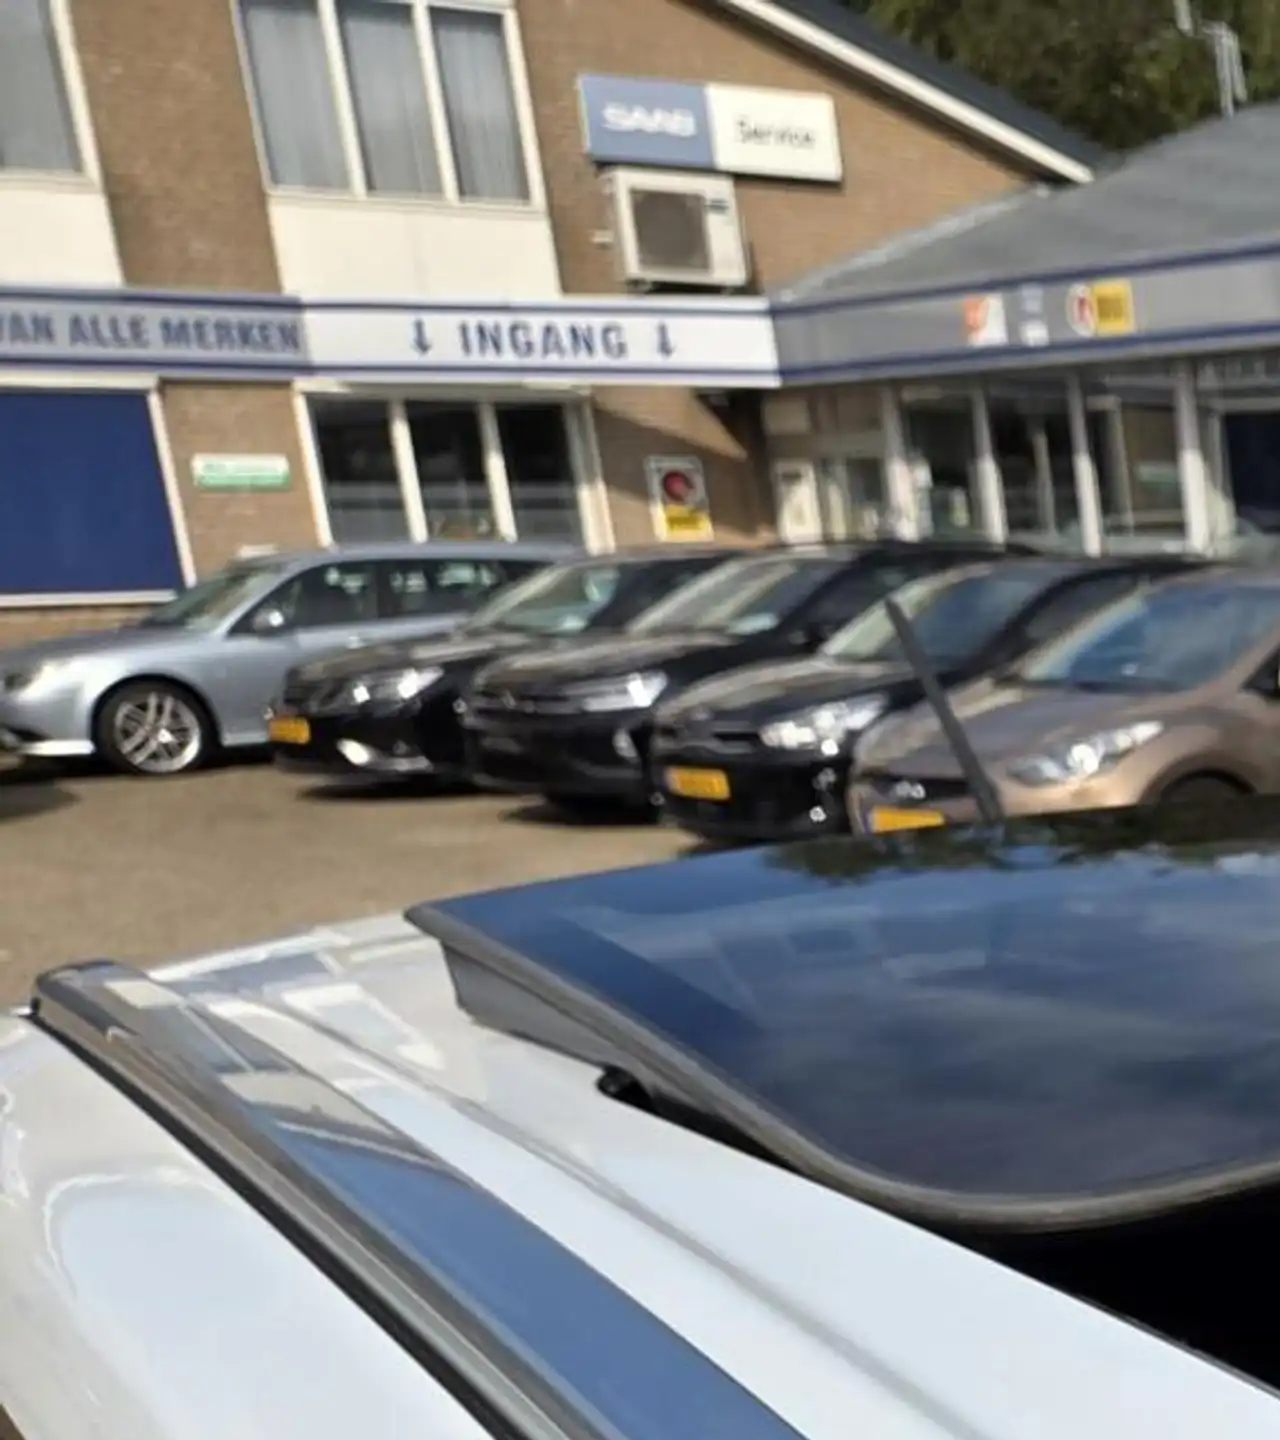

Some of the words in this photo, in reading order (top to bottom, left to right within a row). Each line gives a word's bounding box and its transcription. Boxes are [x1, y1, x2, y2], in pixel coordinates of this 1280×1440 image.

[602, 102, 698, 138] SAAB
[68, 311, 150, 350] ALLE
[159, 314, 301, 354] MERKEN
[458, 320, 628, 360] INGANG
